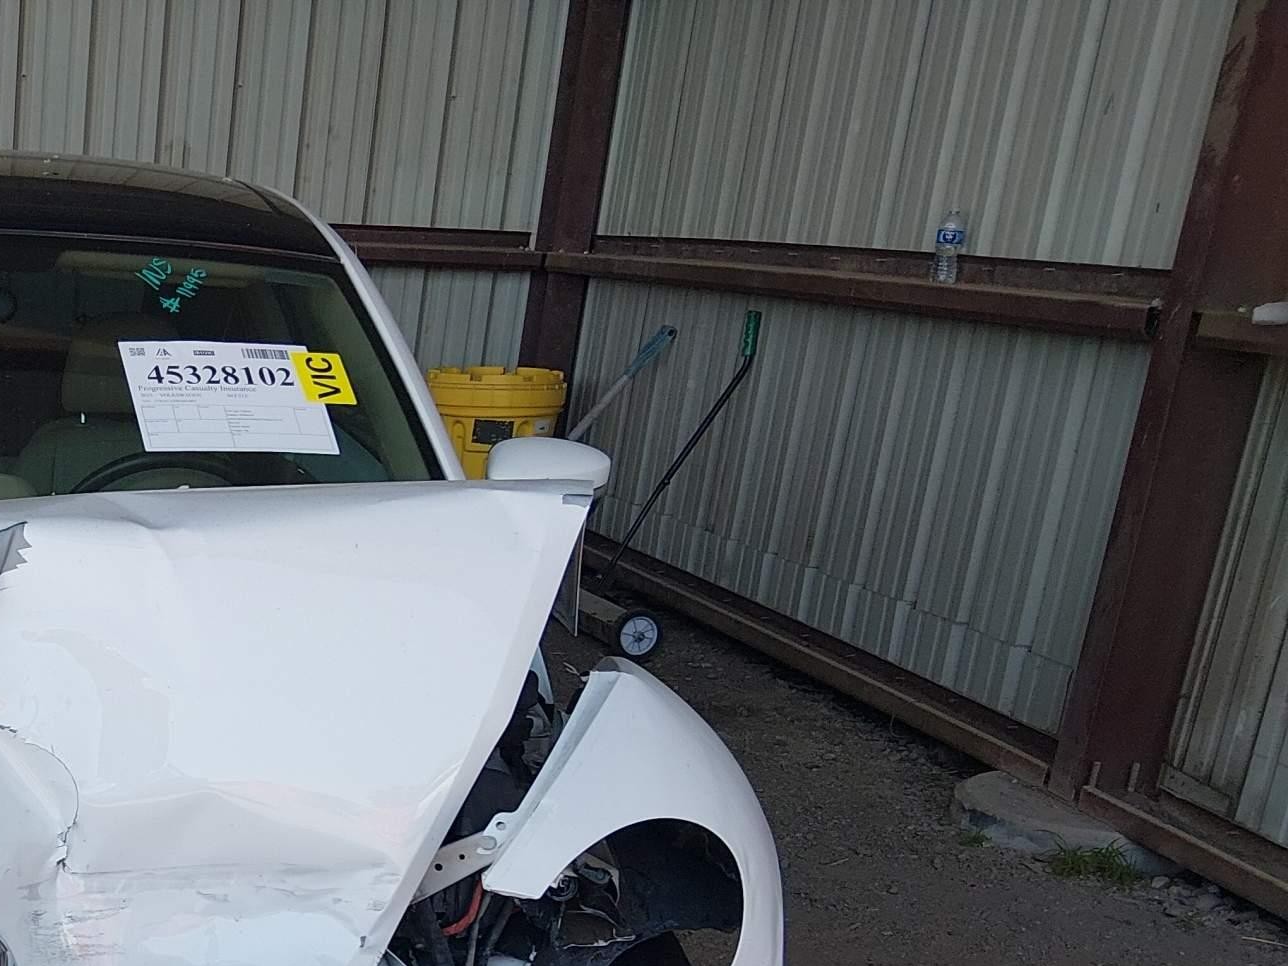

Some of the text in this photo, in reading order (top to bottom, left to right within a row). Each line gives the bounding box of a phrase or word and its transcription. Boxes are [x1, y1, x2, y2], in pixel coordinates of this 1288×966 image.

[134, 257, 172, 291] INS
[147, 364, 295, 387] 45328102
[184, 384, 218, 392] Casualty
[305, 356, 343, 399] VIC
